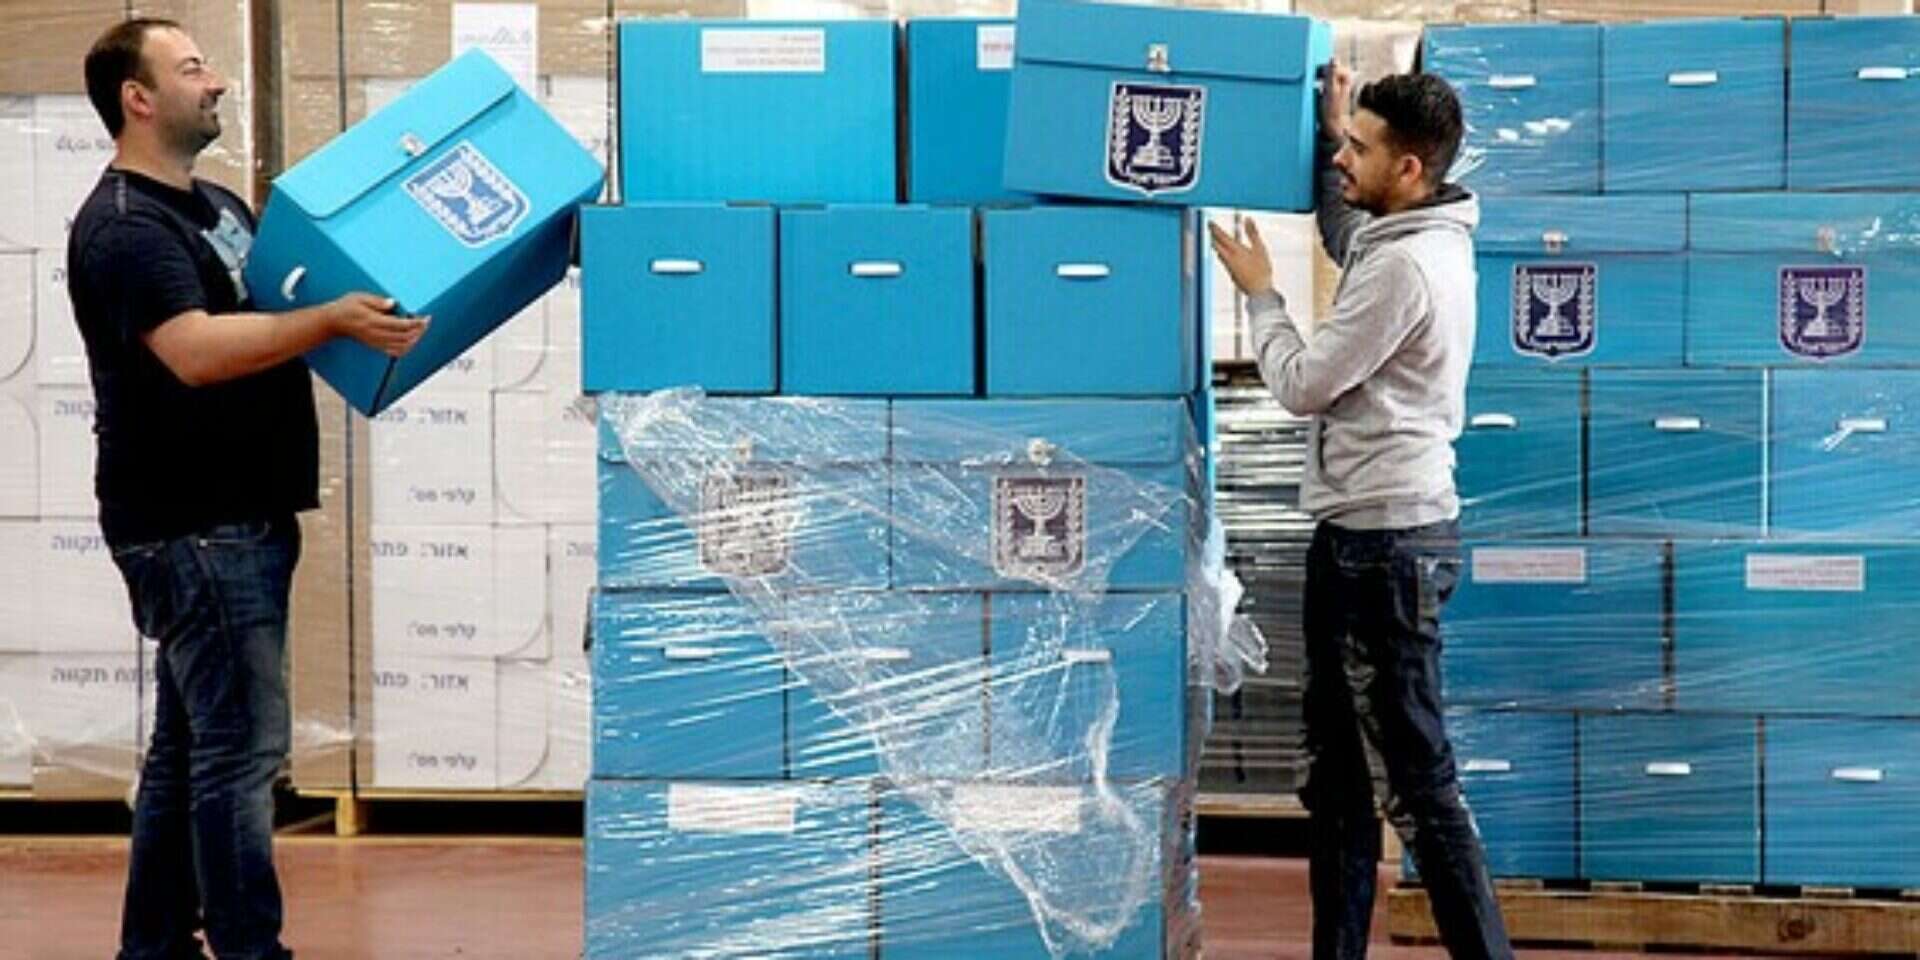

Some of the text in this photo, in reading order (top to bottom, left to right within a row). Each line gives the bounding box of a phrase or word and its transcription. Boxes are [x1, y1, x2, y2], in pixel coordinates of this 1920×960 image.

[420, 541, 469, 559] אזור:
[442, 621, 477, 640] קלפי
[51, 667, 108, 688] תקווה
[420, 672, 470, 691] אזור:
[442, 752, 477, 771] קלפי
